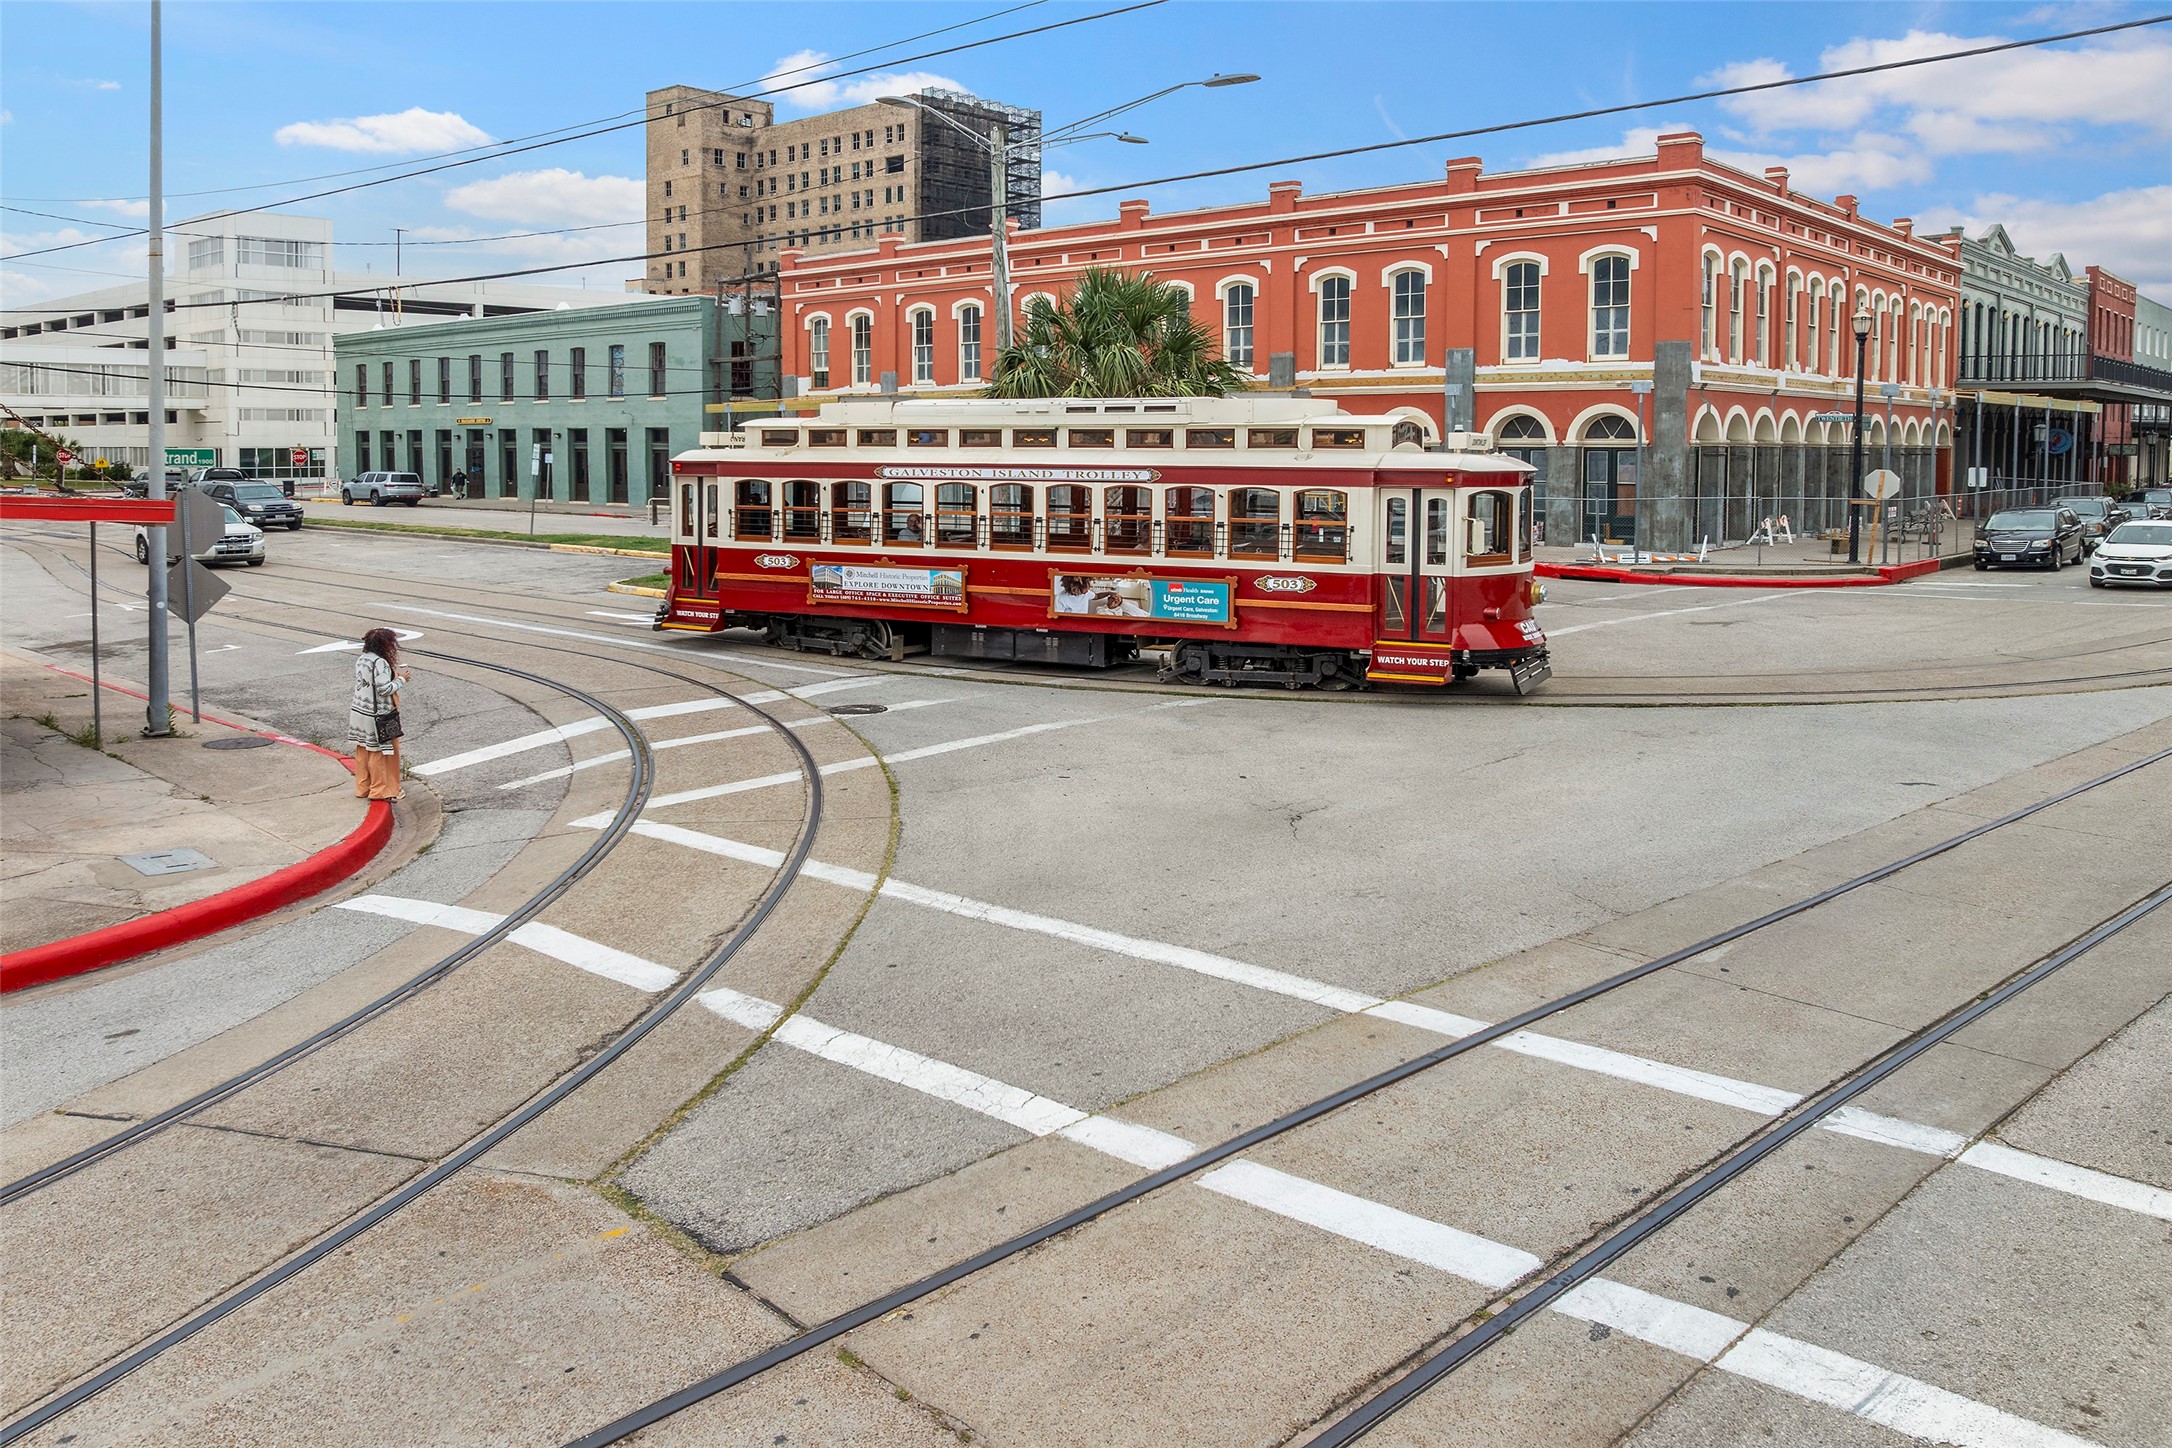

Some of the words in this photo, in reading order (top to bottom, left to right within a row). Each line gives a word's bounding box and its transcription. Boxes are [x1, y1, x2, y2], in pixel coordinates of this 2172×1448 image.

[165, 452, 198, 465] trand
[889, 468, 982, 477] GALVESTON
[992, 469, 1053, 478] ISLAND
[1063, 470, 1142, 479] TROLLEY
[767, 557, 787, 566] 503
[856, 571, 879, 579] Mitchell
[880, 572, 900, 580] Historic
[902, 573, 929, 581] Properties
[844, 580, 879, 589] EXPLORE
[881, 582, 929, 591] DOWNTOWN
[1272, 579, 1299, 589] 503
[1163, 594, 1195, 605] Urgent
[1197, 595, 1220, 605] Care
[695, 611, 709, 619] YOUR
[1186, 612, 1209, 620] Broadway
[1377, 655, 1405, 665] WATCH
[1406, 657, 1428, 666] YOUR
[1429, 659, 1450, 667] STEP
